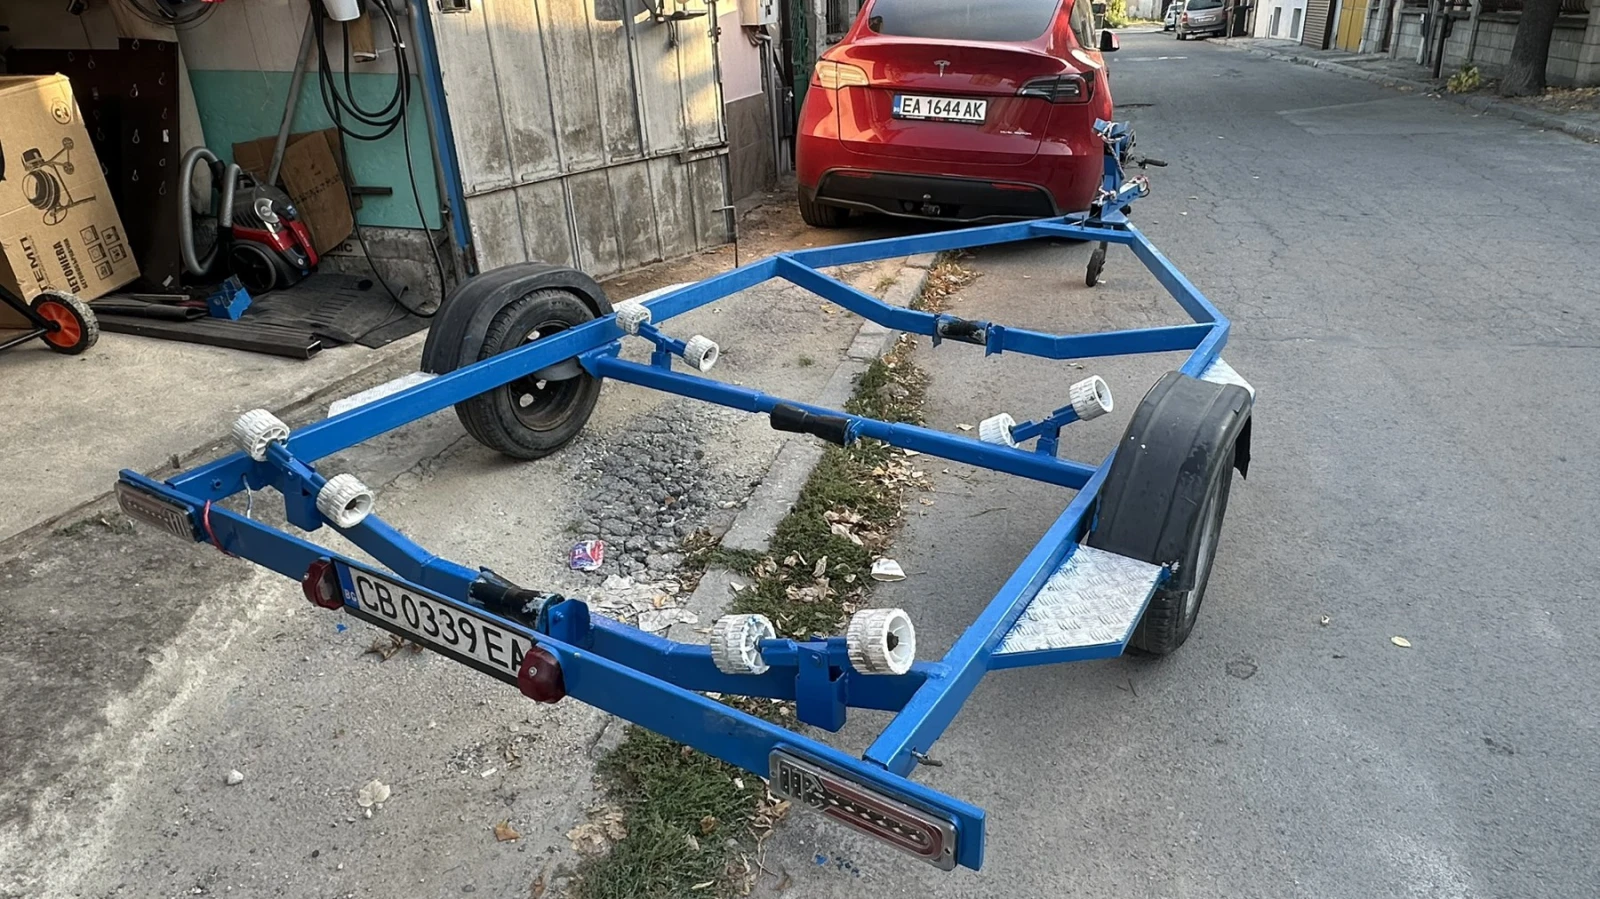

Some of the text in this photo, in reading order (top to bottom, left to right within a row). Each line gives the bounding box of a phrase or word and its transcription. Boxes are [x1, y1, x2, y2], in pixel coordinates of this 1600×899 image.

[902, 98, 921, 114] EA
[927, 99, 961, 116] 1644
[963, 102, 983, 118] AK
[53, 240, 81, 294] BETONIERA
[344, 588, 357, 602] BG
[356, 575, 398, 620] CB
[401, 594, 477, 654] 0339
